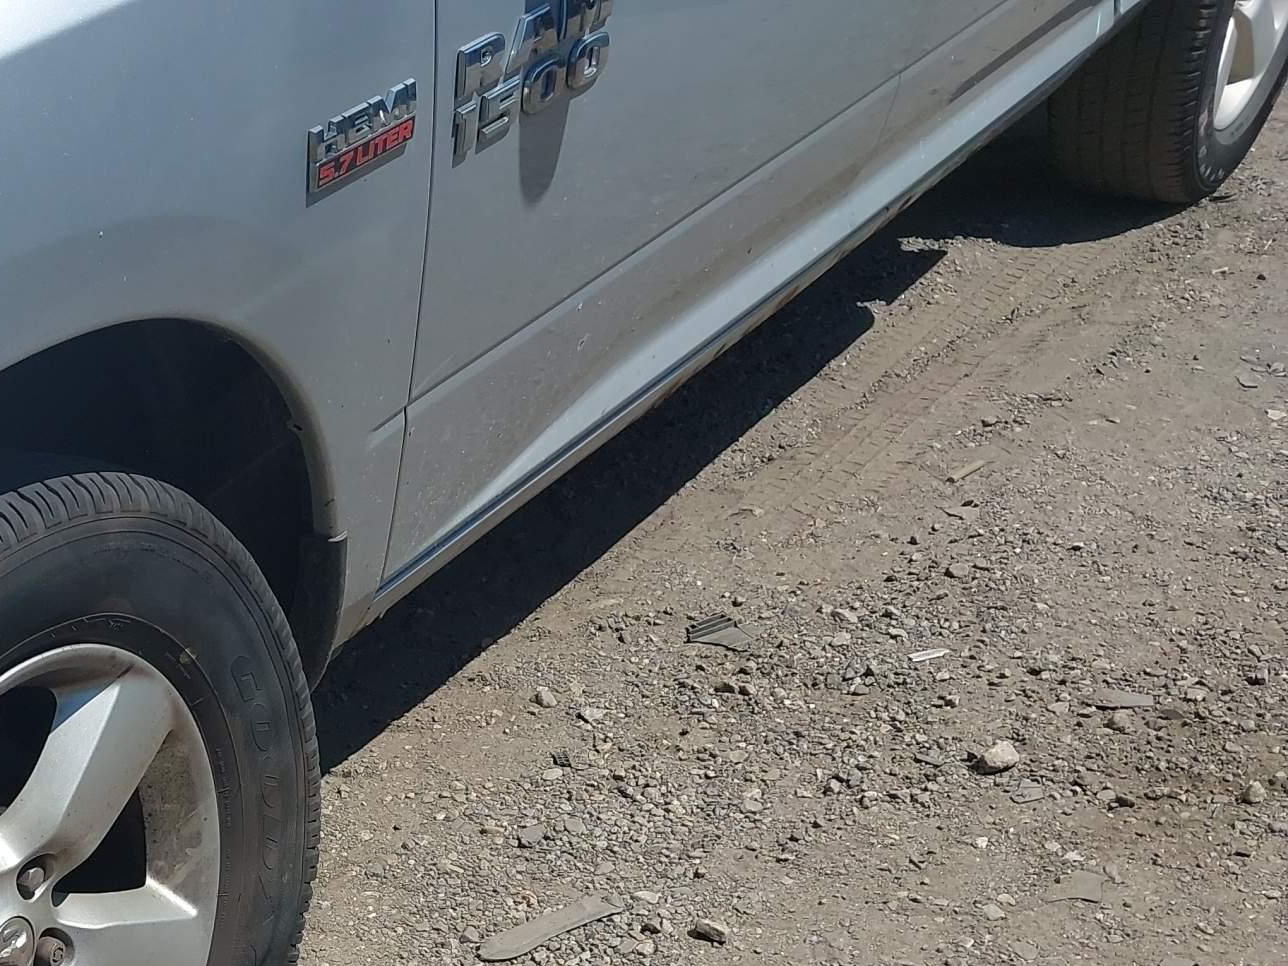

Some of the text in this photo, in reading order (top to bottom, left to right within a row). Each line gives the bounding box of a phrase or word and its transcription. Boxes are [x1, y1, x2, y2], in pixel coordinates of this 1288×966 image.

[307, 78, 417, 164] HEMI
[452, 31, 610, 167] 1500
[318, 118, 413, 187] 5.7 LITER
